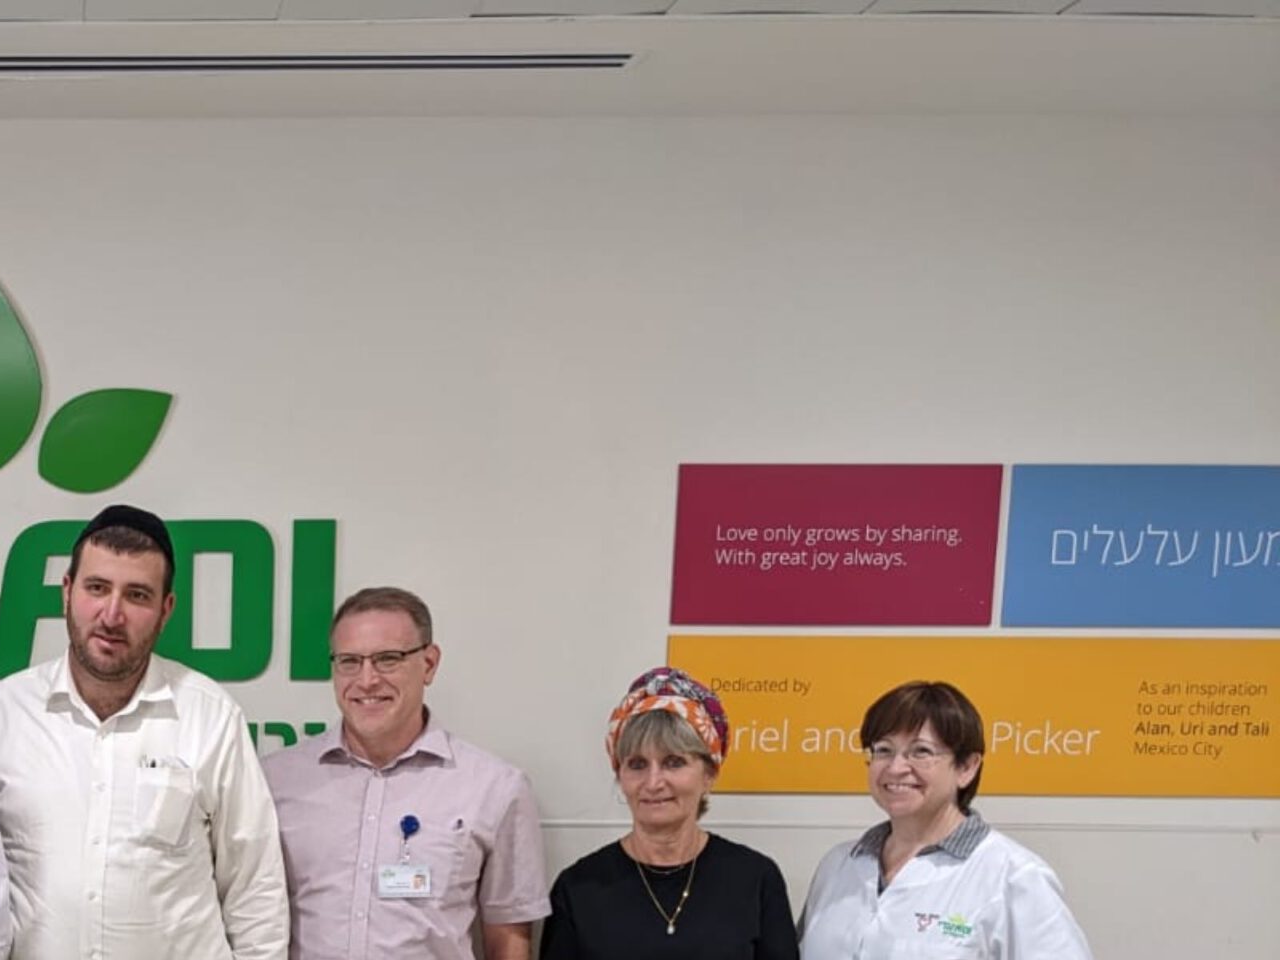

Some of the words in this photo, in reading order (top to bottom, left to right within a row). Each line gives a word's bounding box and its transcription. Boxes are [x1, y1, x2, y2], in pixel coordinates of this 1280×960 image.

[716, 525, 758, 541] Love
[763, 525, 802, 546] only
[805, 528, 860, 546] grows
[865, 525, 887, 546] by
[891, 525, 962, 546] sharing.
[1051, 523, 1199, 566] עלעלים
[715, 549, 756, 566] With
[760, 551, 808, 570] great
[811, 550, 839, 570] joy
[843, 549, 907, 570] always.
[710, 677, 788, 693] Dedicated
[793, 678, 812, 696] by
[1138, 681, 1158, 695] As
[1161, 683, 1181, 695] an
[1185, 682, 1268, 698] inspiration
[1137, 702, 1153, 716] to
[1157, 704, 1182, 716] our
[1188, 700, 1251, 716] children
[733, 719, 789, 752] riel
[991, 720, 1101, 755] Picker
[1135, 721, 1175, 737] Alan,
[1180, 721, 1204, 736] Uri
[1208, 721, 1238, 736] and
[1243, 721, 1270, 736] Tali
[1133, 741, 1188, 756] Mexico
[1192, 741, 1223, 760] City
